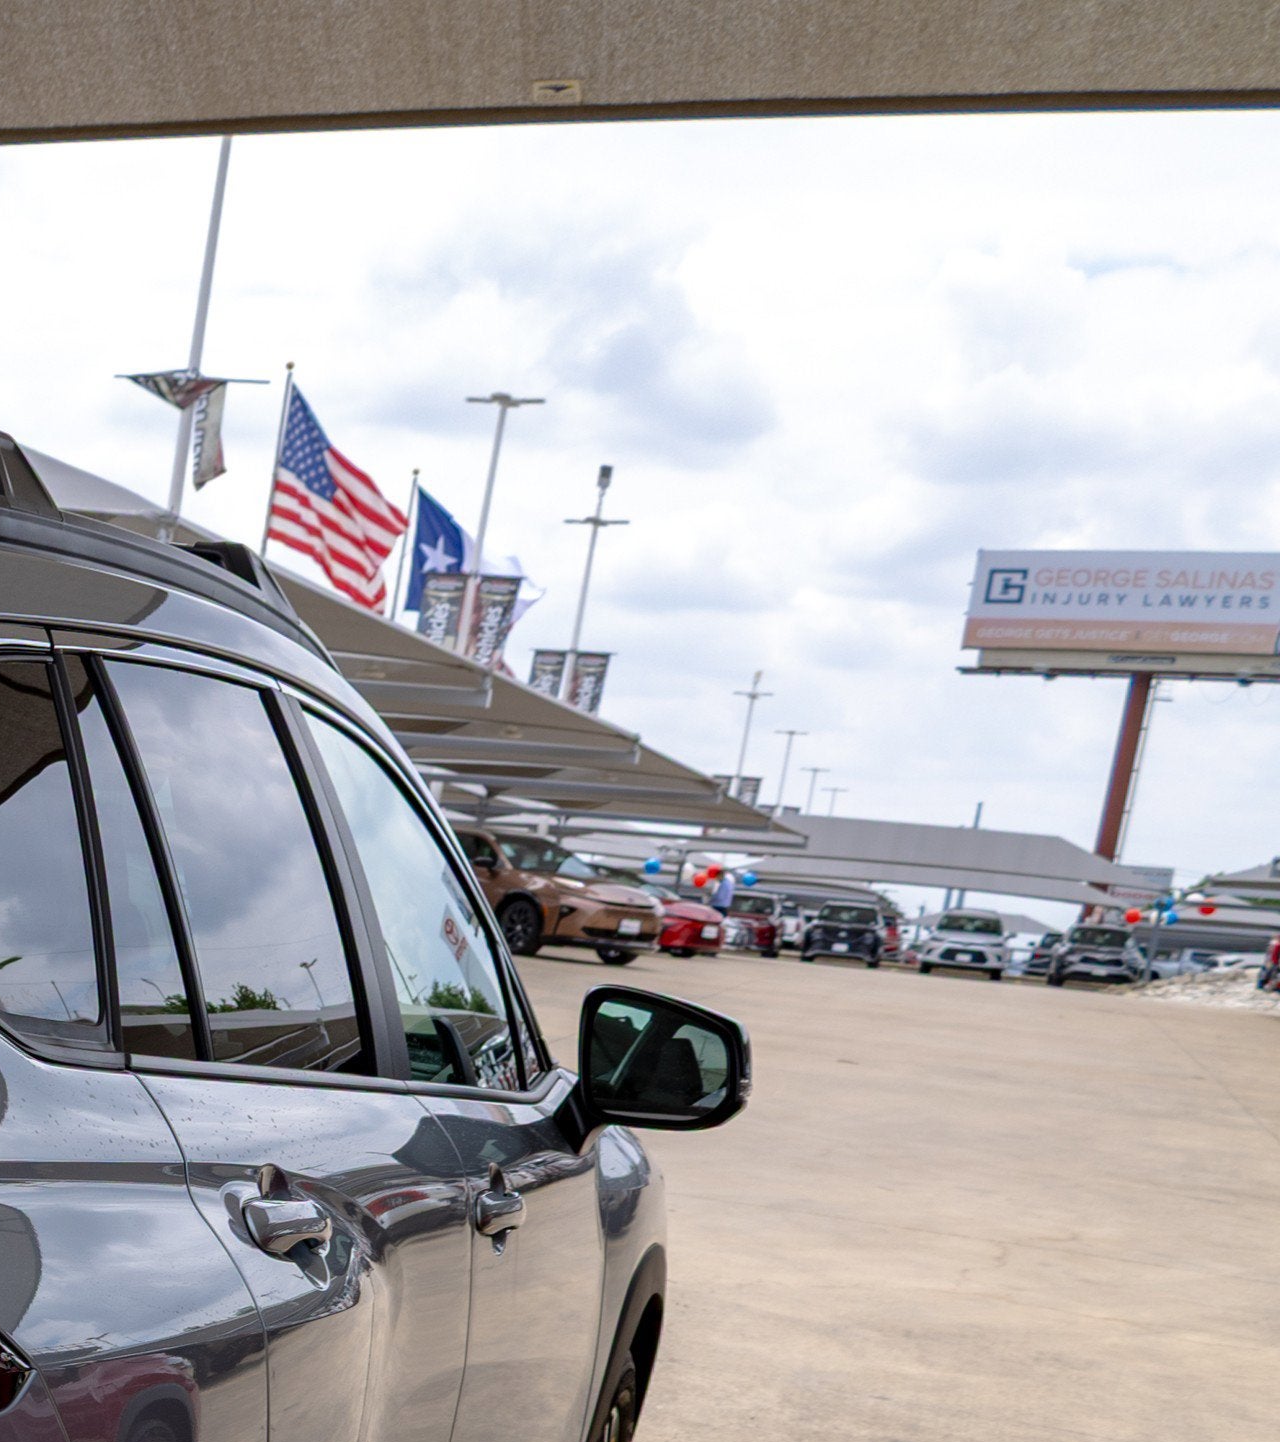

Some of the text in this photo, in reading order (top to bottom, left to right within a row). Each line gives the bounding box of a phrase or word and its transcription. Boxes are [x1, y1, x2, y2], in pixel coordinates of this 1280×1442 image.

[1034, 566, 1275, 591] GEORGE SALINAS
[1030, 591, 1271, 610] INJURY LAWYERS
